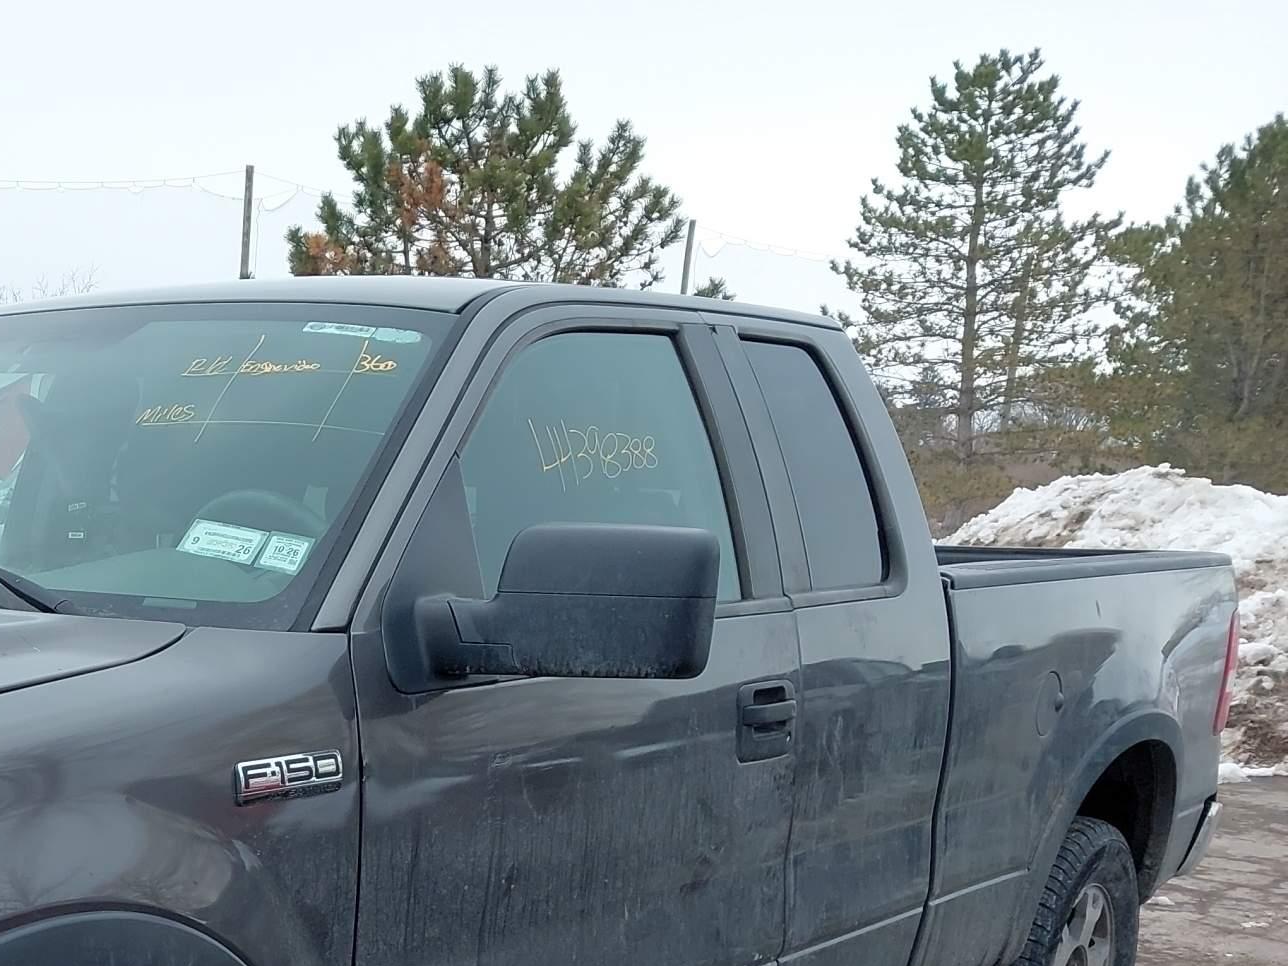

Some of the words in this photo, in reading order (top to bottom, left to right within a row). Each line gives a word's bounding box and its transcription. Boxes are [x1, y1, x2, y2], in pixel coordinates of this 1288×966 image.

[352, 353, 398, 373] 360
[528, 418, 659, 494] 44398388
[191, 536, 200, 545] 9
[235, 545, 251, 555] 26
[286, 547, 299, 556] 26
